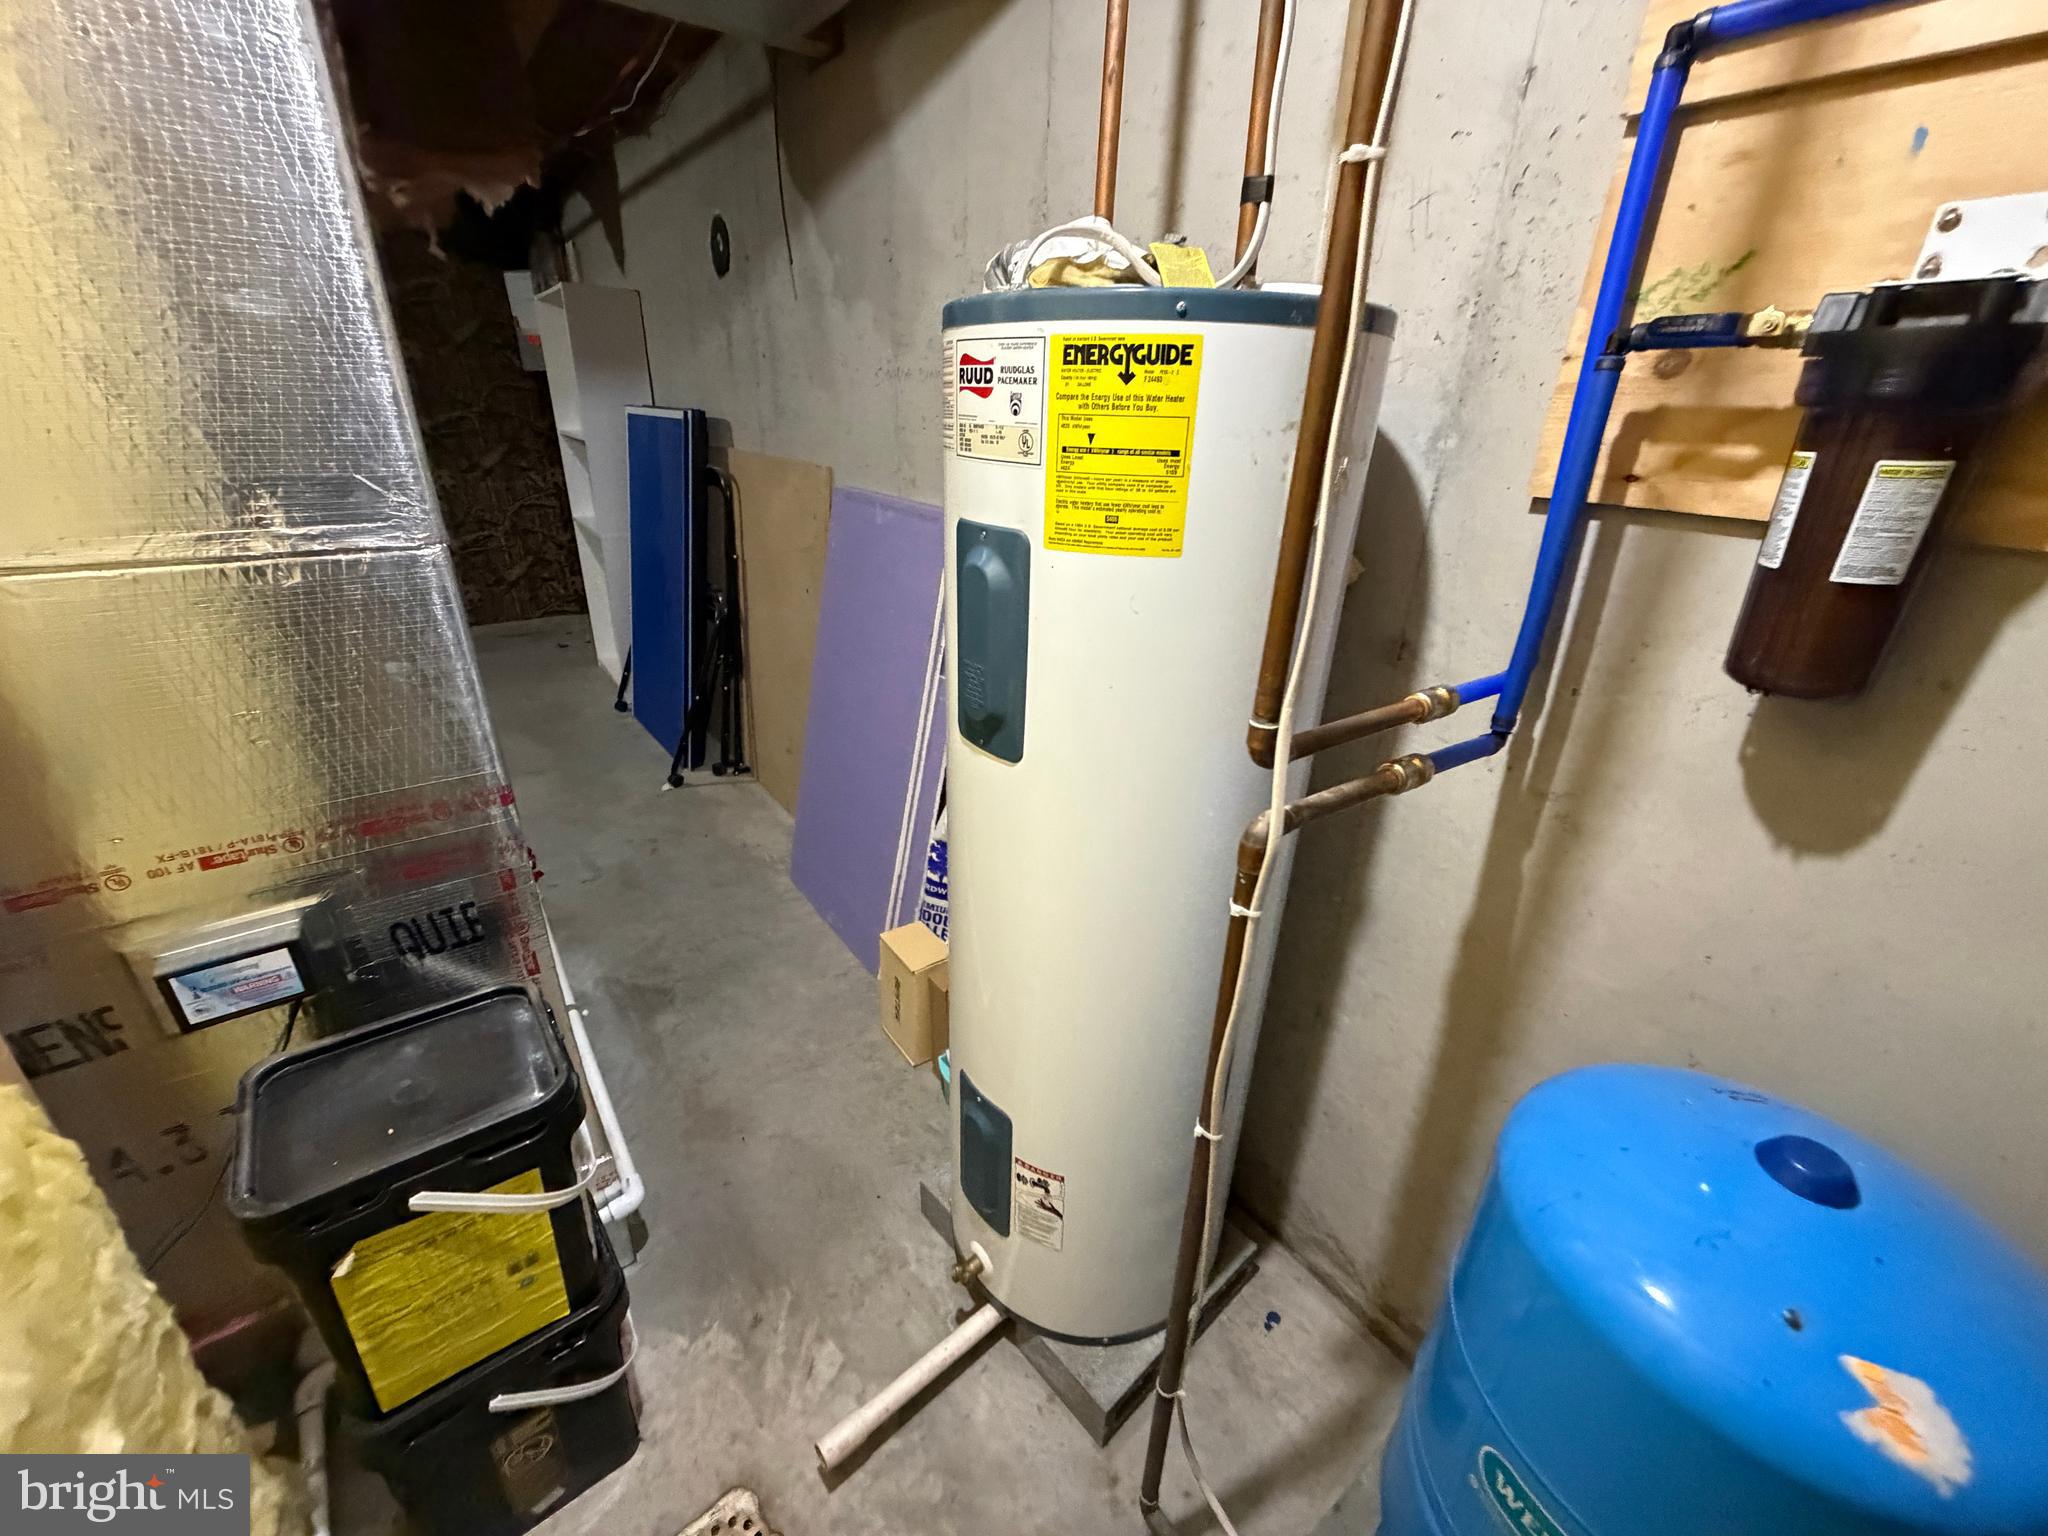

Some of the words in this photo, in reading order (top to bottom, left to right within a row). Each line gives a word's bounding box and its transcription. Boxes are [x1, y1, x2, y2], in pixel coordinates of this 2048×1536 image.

[1062, 343, 1195, 369] ENERGYGUIDE
[1000, 365, 1035, 375] RUUDGLAS
[959, 367, 994, 385] RUUD
[997, 376, 1038, 386] PACEMAKER
[1056, 392, 1078, 401] Compare
[1091, 393, 1110, 402] Energy
[1113, 393, 1124, 401] Use
[1133, 394, 1144, 402] this
[1146, 394, 1164, 403] Water
[1165, 395, 1185, 403] Heater
[1091, 403, 1110, 411] Others
[1112, 403, 1131, 411] Before
[1145, 404, 1159, 413] Buy.
[146, 865, 174, 880] 100
[176, 860, 195, 874] AF
[205, 843, 279, 869] Shurtape
